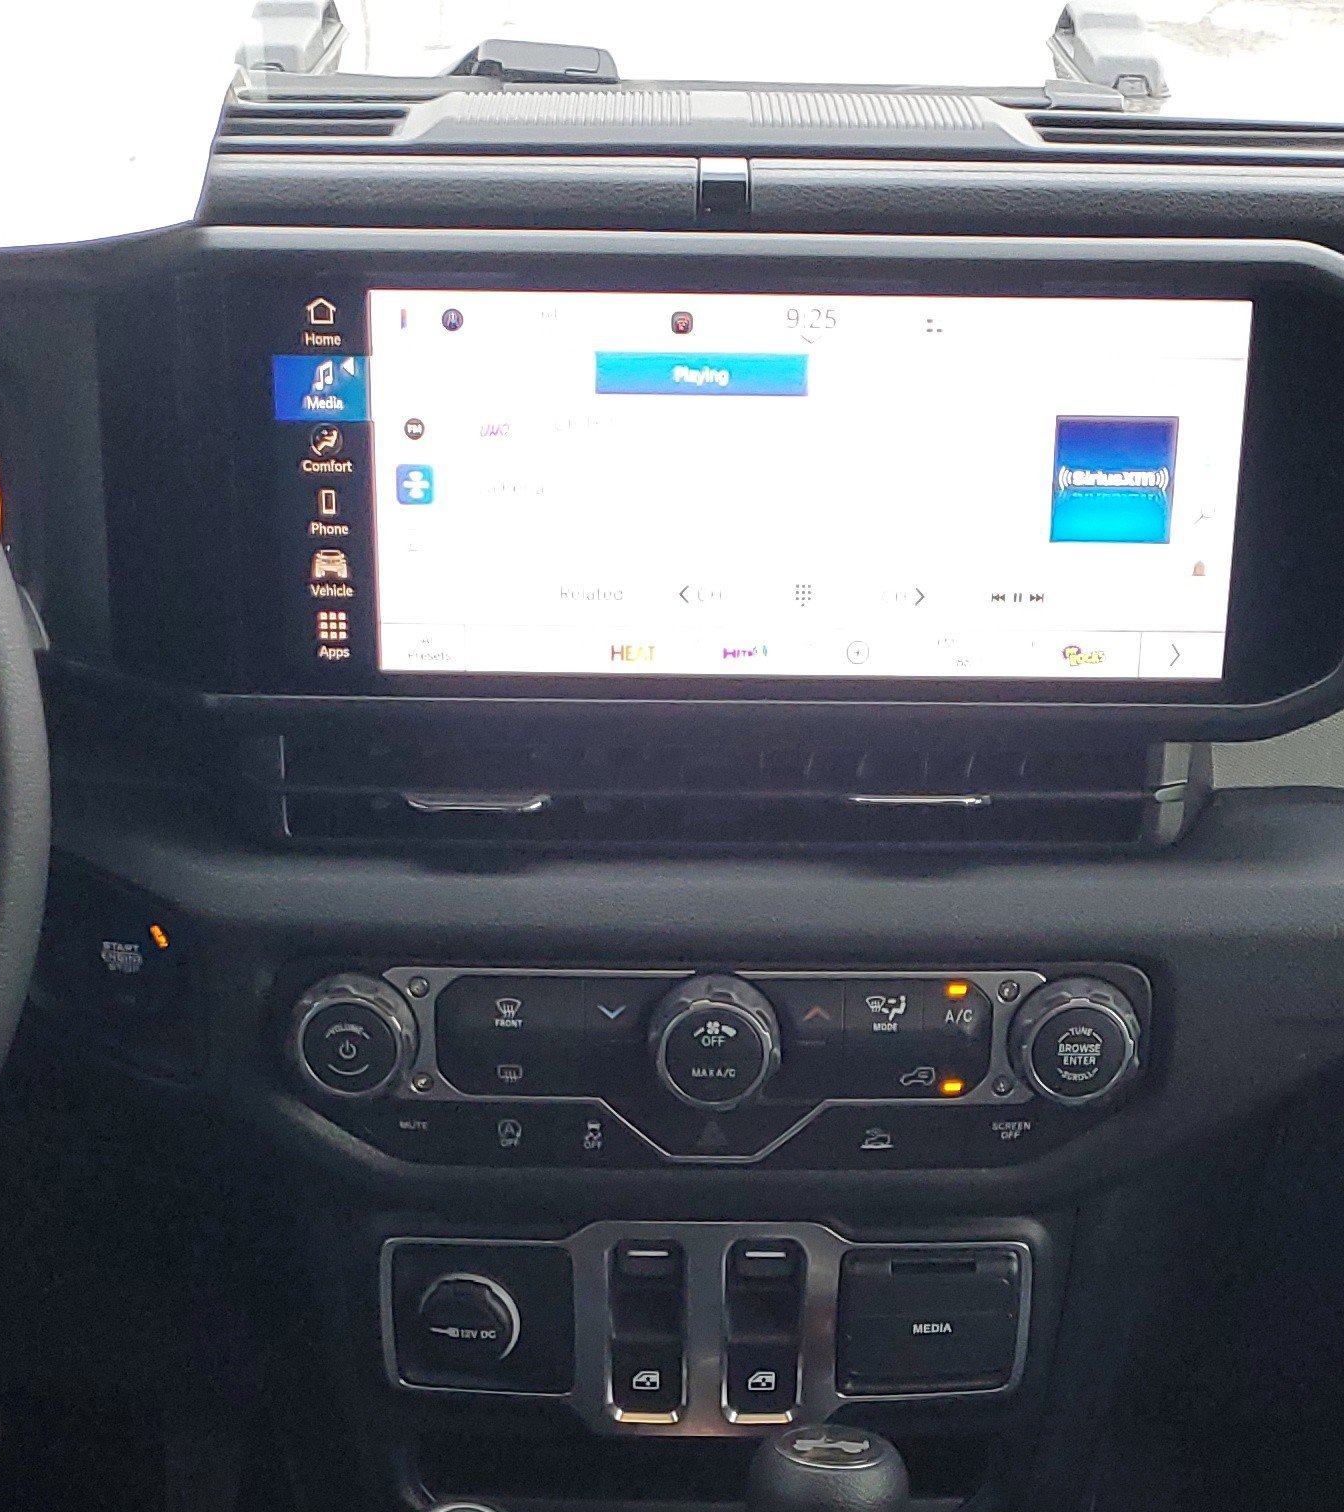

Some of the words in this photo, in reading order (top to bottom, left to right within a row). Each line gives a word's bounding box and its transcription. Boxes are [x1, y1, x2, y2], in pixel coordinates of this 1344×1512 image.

[786, 308, 838, 331] 9:25
[304, 333, 342, 348] Home
[673, 365, 730, 388] Playing
[305, 395, 345, 411] Media
[302, 459, 354, 474] Comfort
[310, 522, 350, 537] Phone
[310, 583, 355, 599] Vehicle
[318, 645, 351, 661] Apps
[611, 645, 656, 661] HEAT
[944, 1009, 974, 1025] A/C
[329, 1022, 366, 1035] VOLUME
[494, 1020, 523, 1029] FRONT
[872, 1022, 898, 1033] MODE
[1069, 1026, 1093, 1036] TUNE
[701, 1035, 725, 1047] OFF
[1058, 1043, 1101, 1053] BROWSE
[1063, 1056, 1096, 1066] ENTER
[716, 1067, 737, 1078] A/C
[1061, 1070, 1095, 1081] SCROLL
[991, 1121, 1032, 1131] SCREEN
[480, 1330, 497, 1339] DC
[912, 1321, 953, 1335] MEDIA
